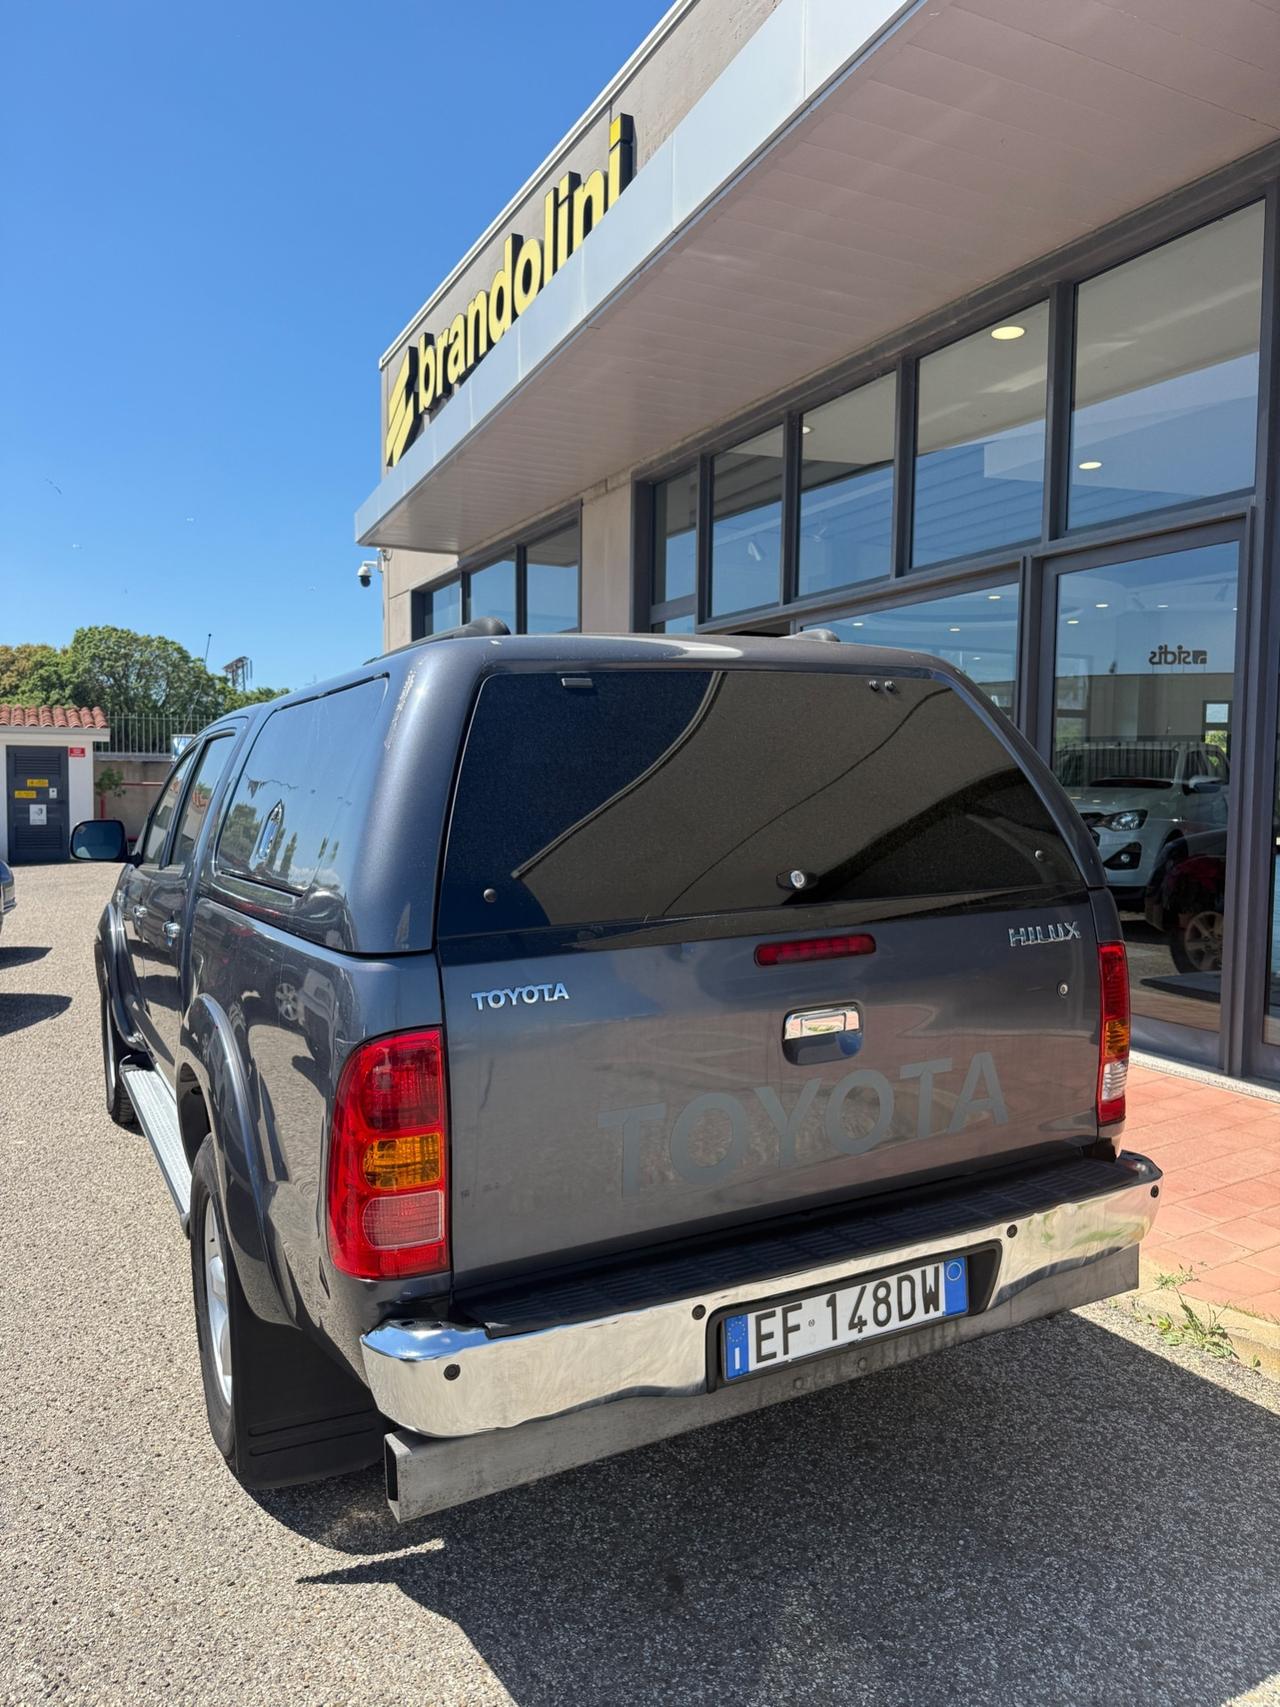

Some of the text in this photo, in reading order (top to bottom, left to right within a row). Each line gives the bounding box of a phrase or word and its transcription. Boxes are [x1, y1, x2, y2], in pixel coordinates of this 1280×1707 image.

[418, 113, 633, 413] brandolini
[1009, 921, 1081, 947] HILUX
[471, 982, 570, 1011] TOYOTA
[599, 1051, 1008, 1198] TOYOTA
[755, 1265, 940, 1364] EF 148DW
